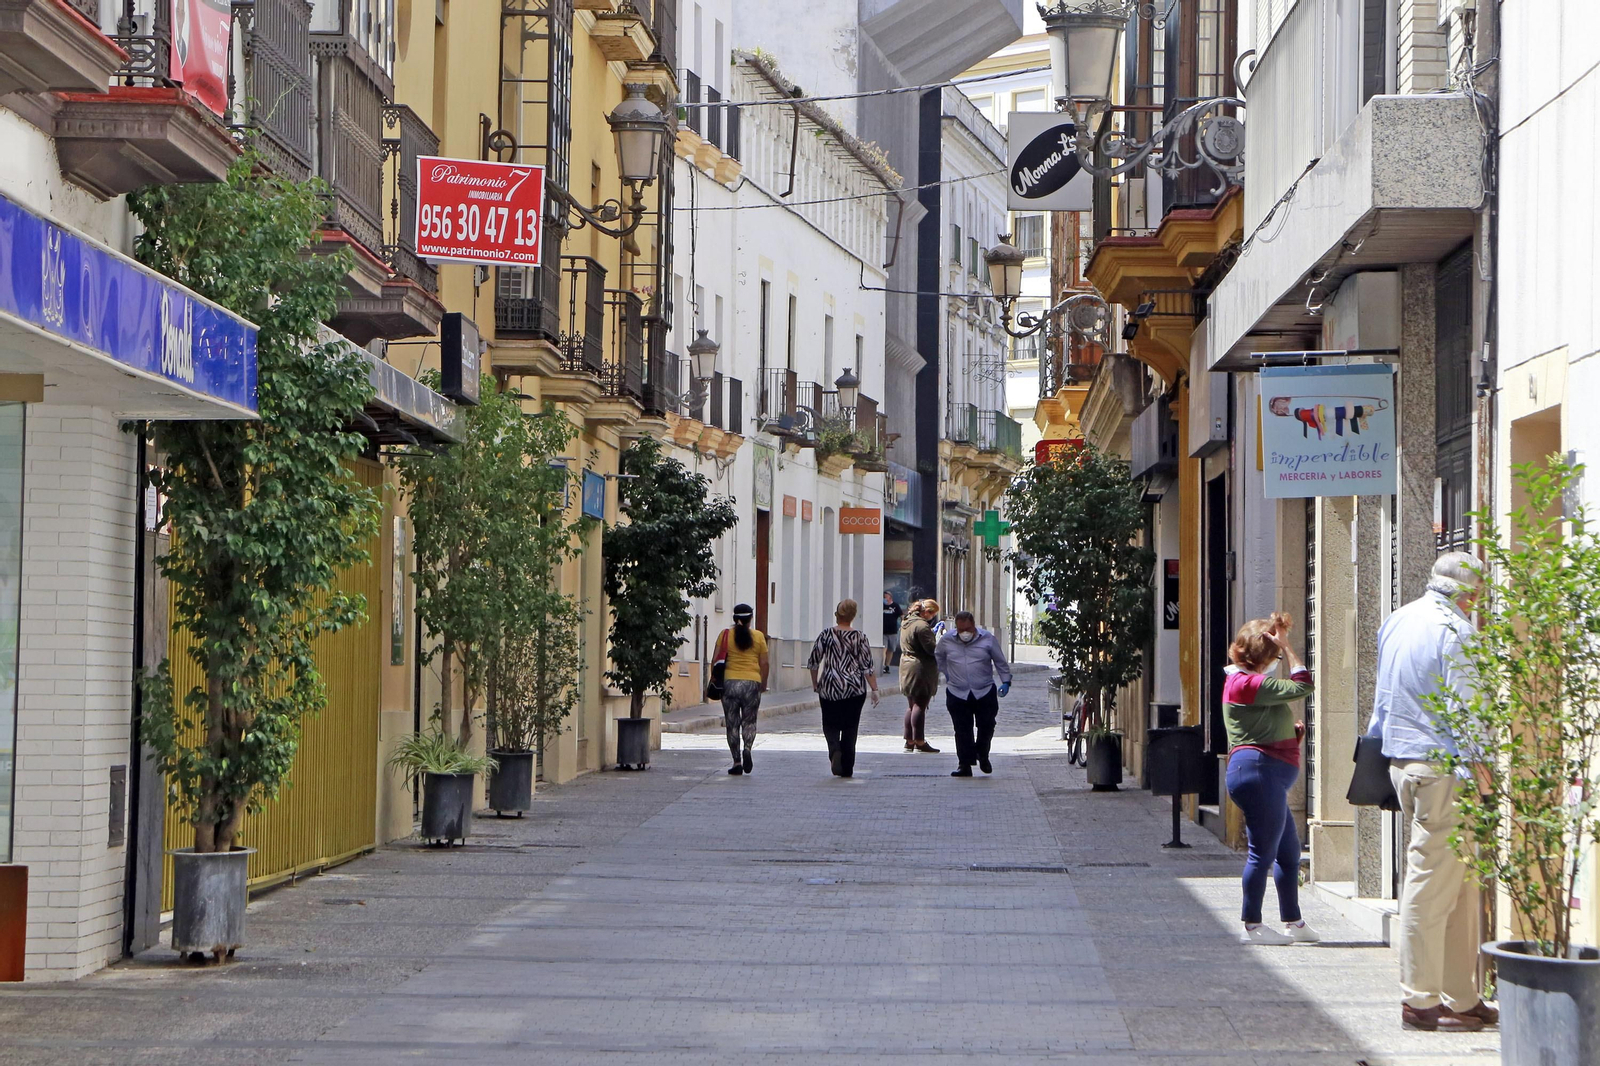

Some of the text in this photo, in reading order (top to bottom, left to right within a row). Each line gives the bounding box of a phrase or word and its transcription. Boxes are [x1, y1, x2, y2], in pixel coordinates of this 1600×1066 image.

[430, 164, 531, 202] Patrimonio 7
[1015, 151, 1062, 196] Monna
[467, 190, 503, 201] INMOBILIARIA
[420, 203, 537, 247] 956 30 47 13
[421, 245, 535, 261] www.patrimonio7.com
[1270, 442, 1390, 471] imperdible
[1279, 470, 1382, 482] MERCERIA y LABORES
[842, 516, 880, 526] GOCCO
